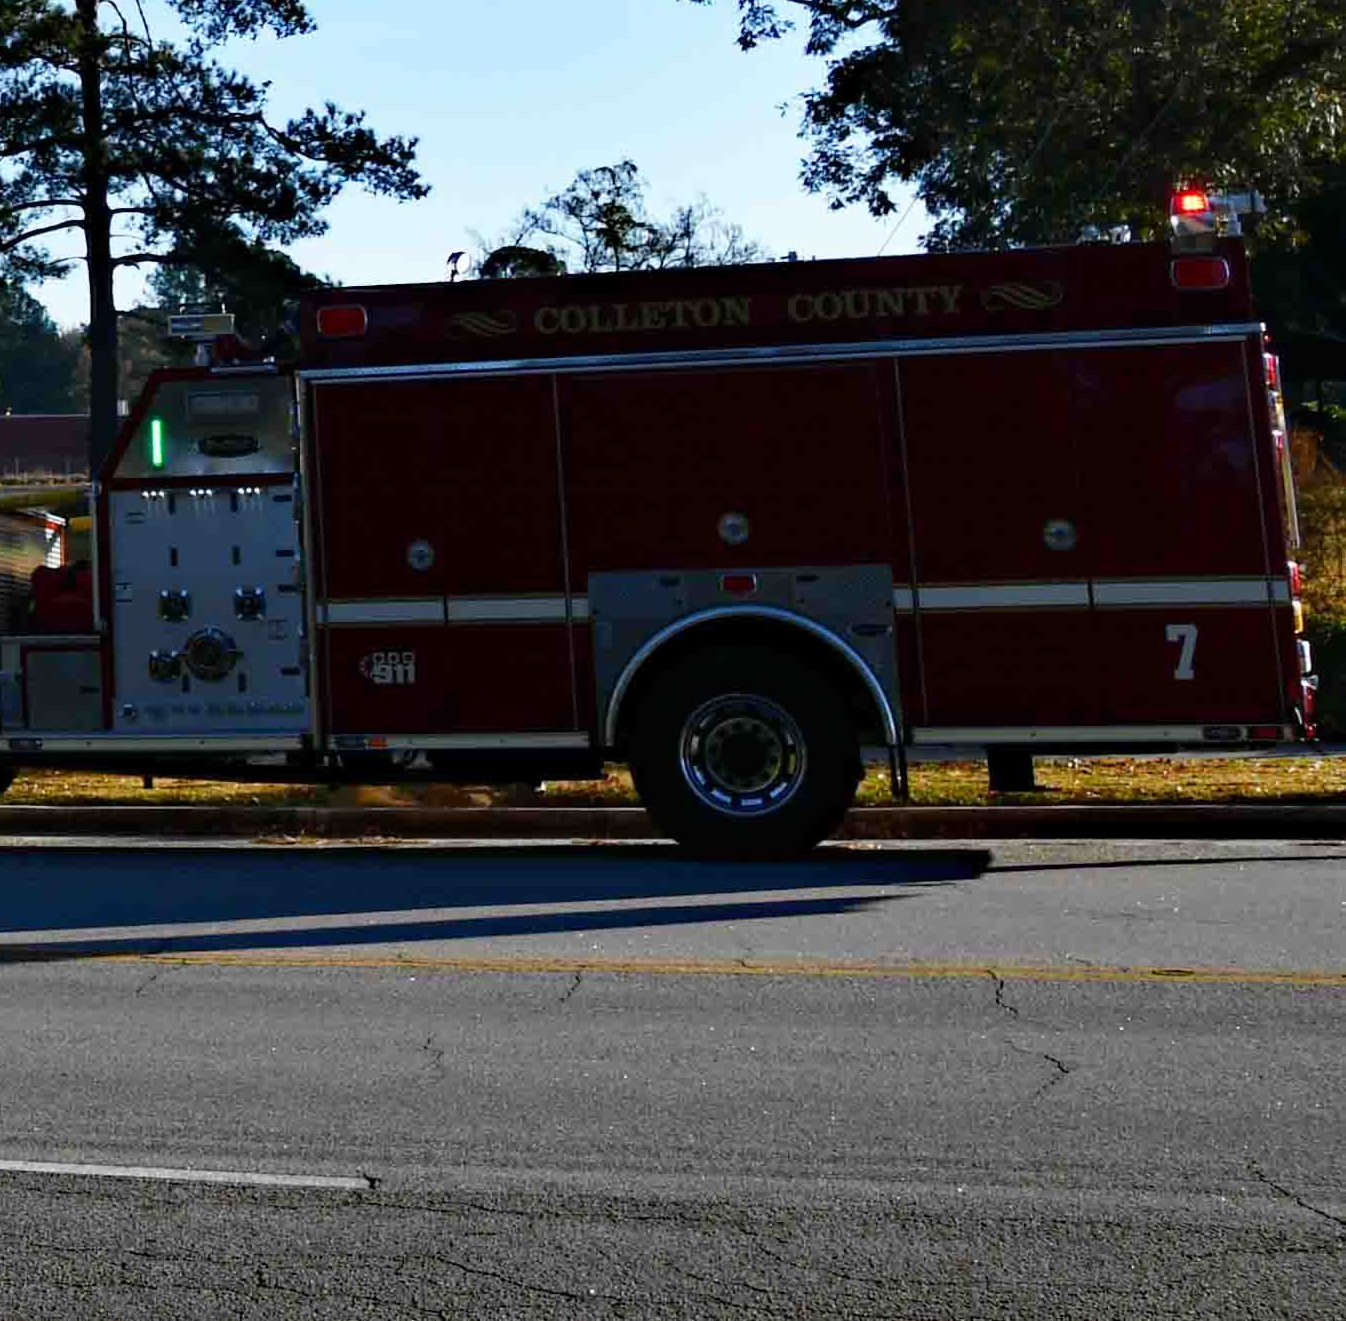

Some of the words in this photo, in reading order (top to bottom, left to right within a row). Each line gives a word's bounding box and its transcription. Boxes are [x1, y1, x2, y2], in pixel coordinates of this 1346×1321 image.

[533, 296, 753, 334] COLLETON
[788, 284, 964, 324] COUNTY
[371, 663, 417, 685] 911
[1164, 623, 1198, 681] 7
